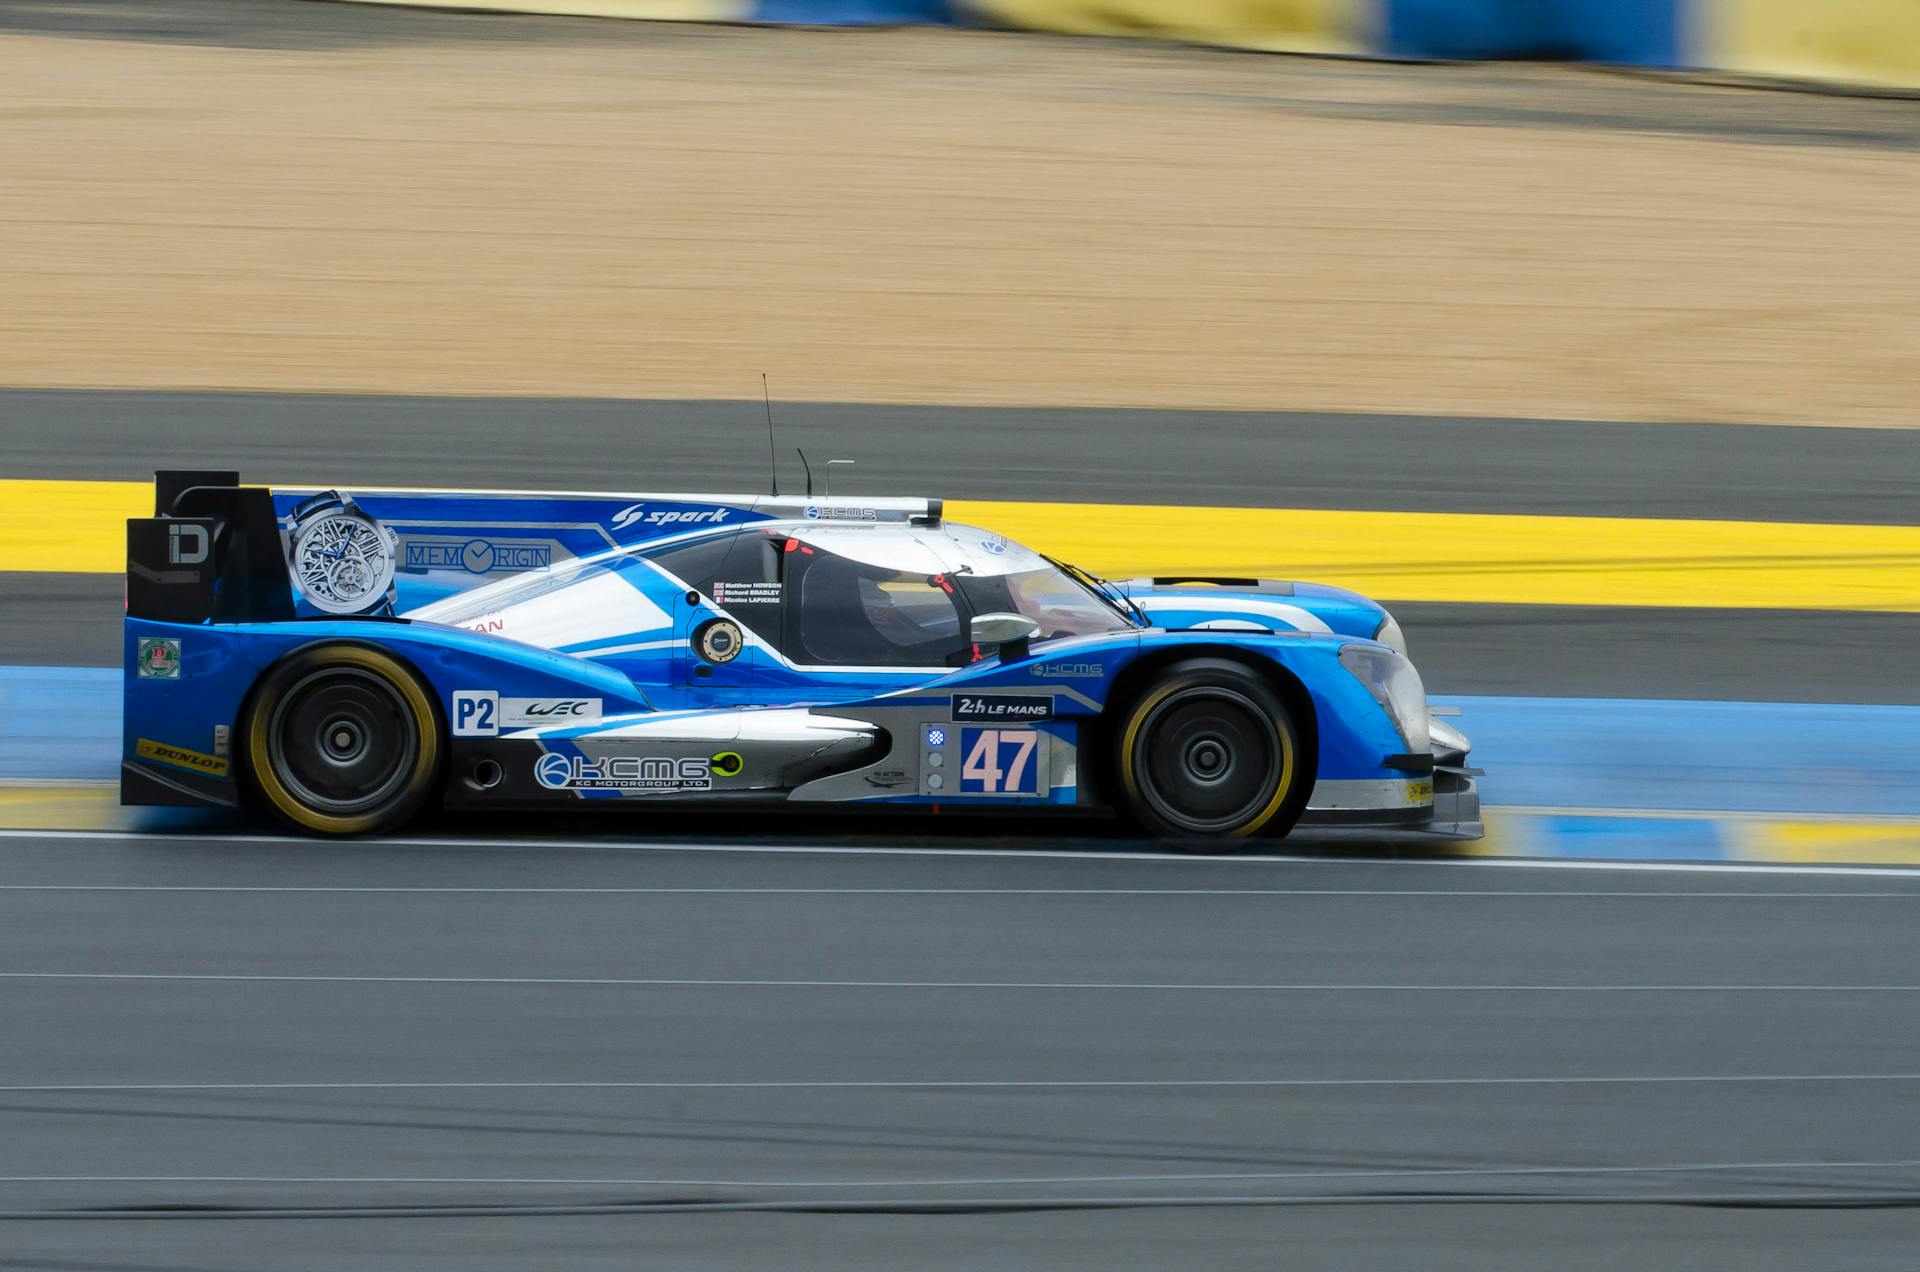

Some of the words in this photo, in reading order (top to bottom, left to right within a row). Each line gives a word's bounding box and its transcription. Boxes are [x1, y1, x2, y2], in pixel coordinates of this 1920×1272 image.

[645, 508, 730, 526] spark
[1045, 663, 1103, 673] KCMG
[457, 698, 494, 730] P2
[525, 701, 589, 716] WEC
[987, 704, 1005, 715] LE
[1006, 704, 1047, 716] MANS
[154, 746, 226, 770] DUNLOP
[962, 730, 1038, 792] 47
[573, 756, 710, 780] KCMG
[595, 780, 679, 788] MOTORGROUP
